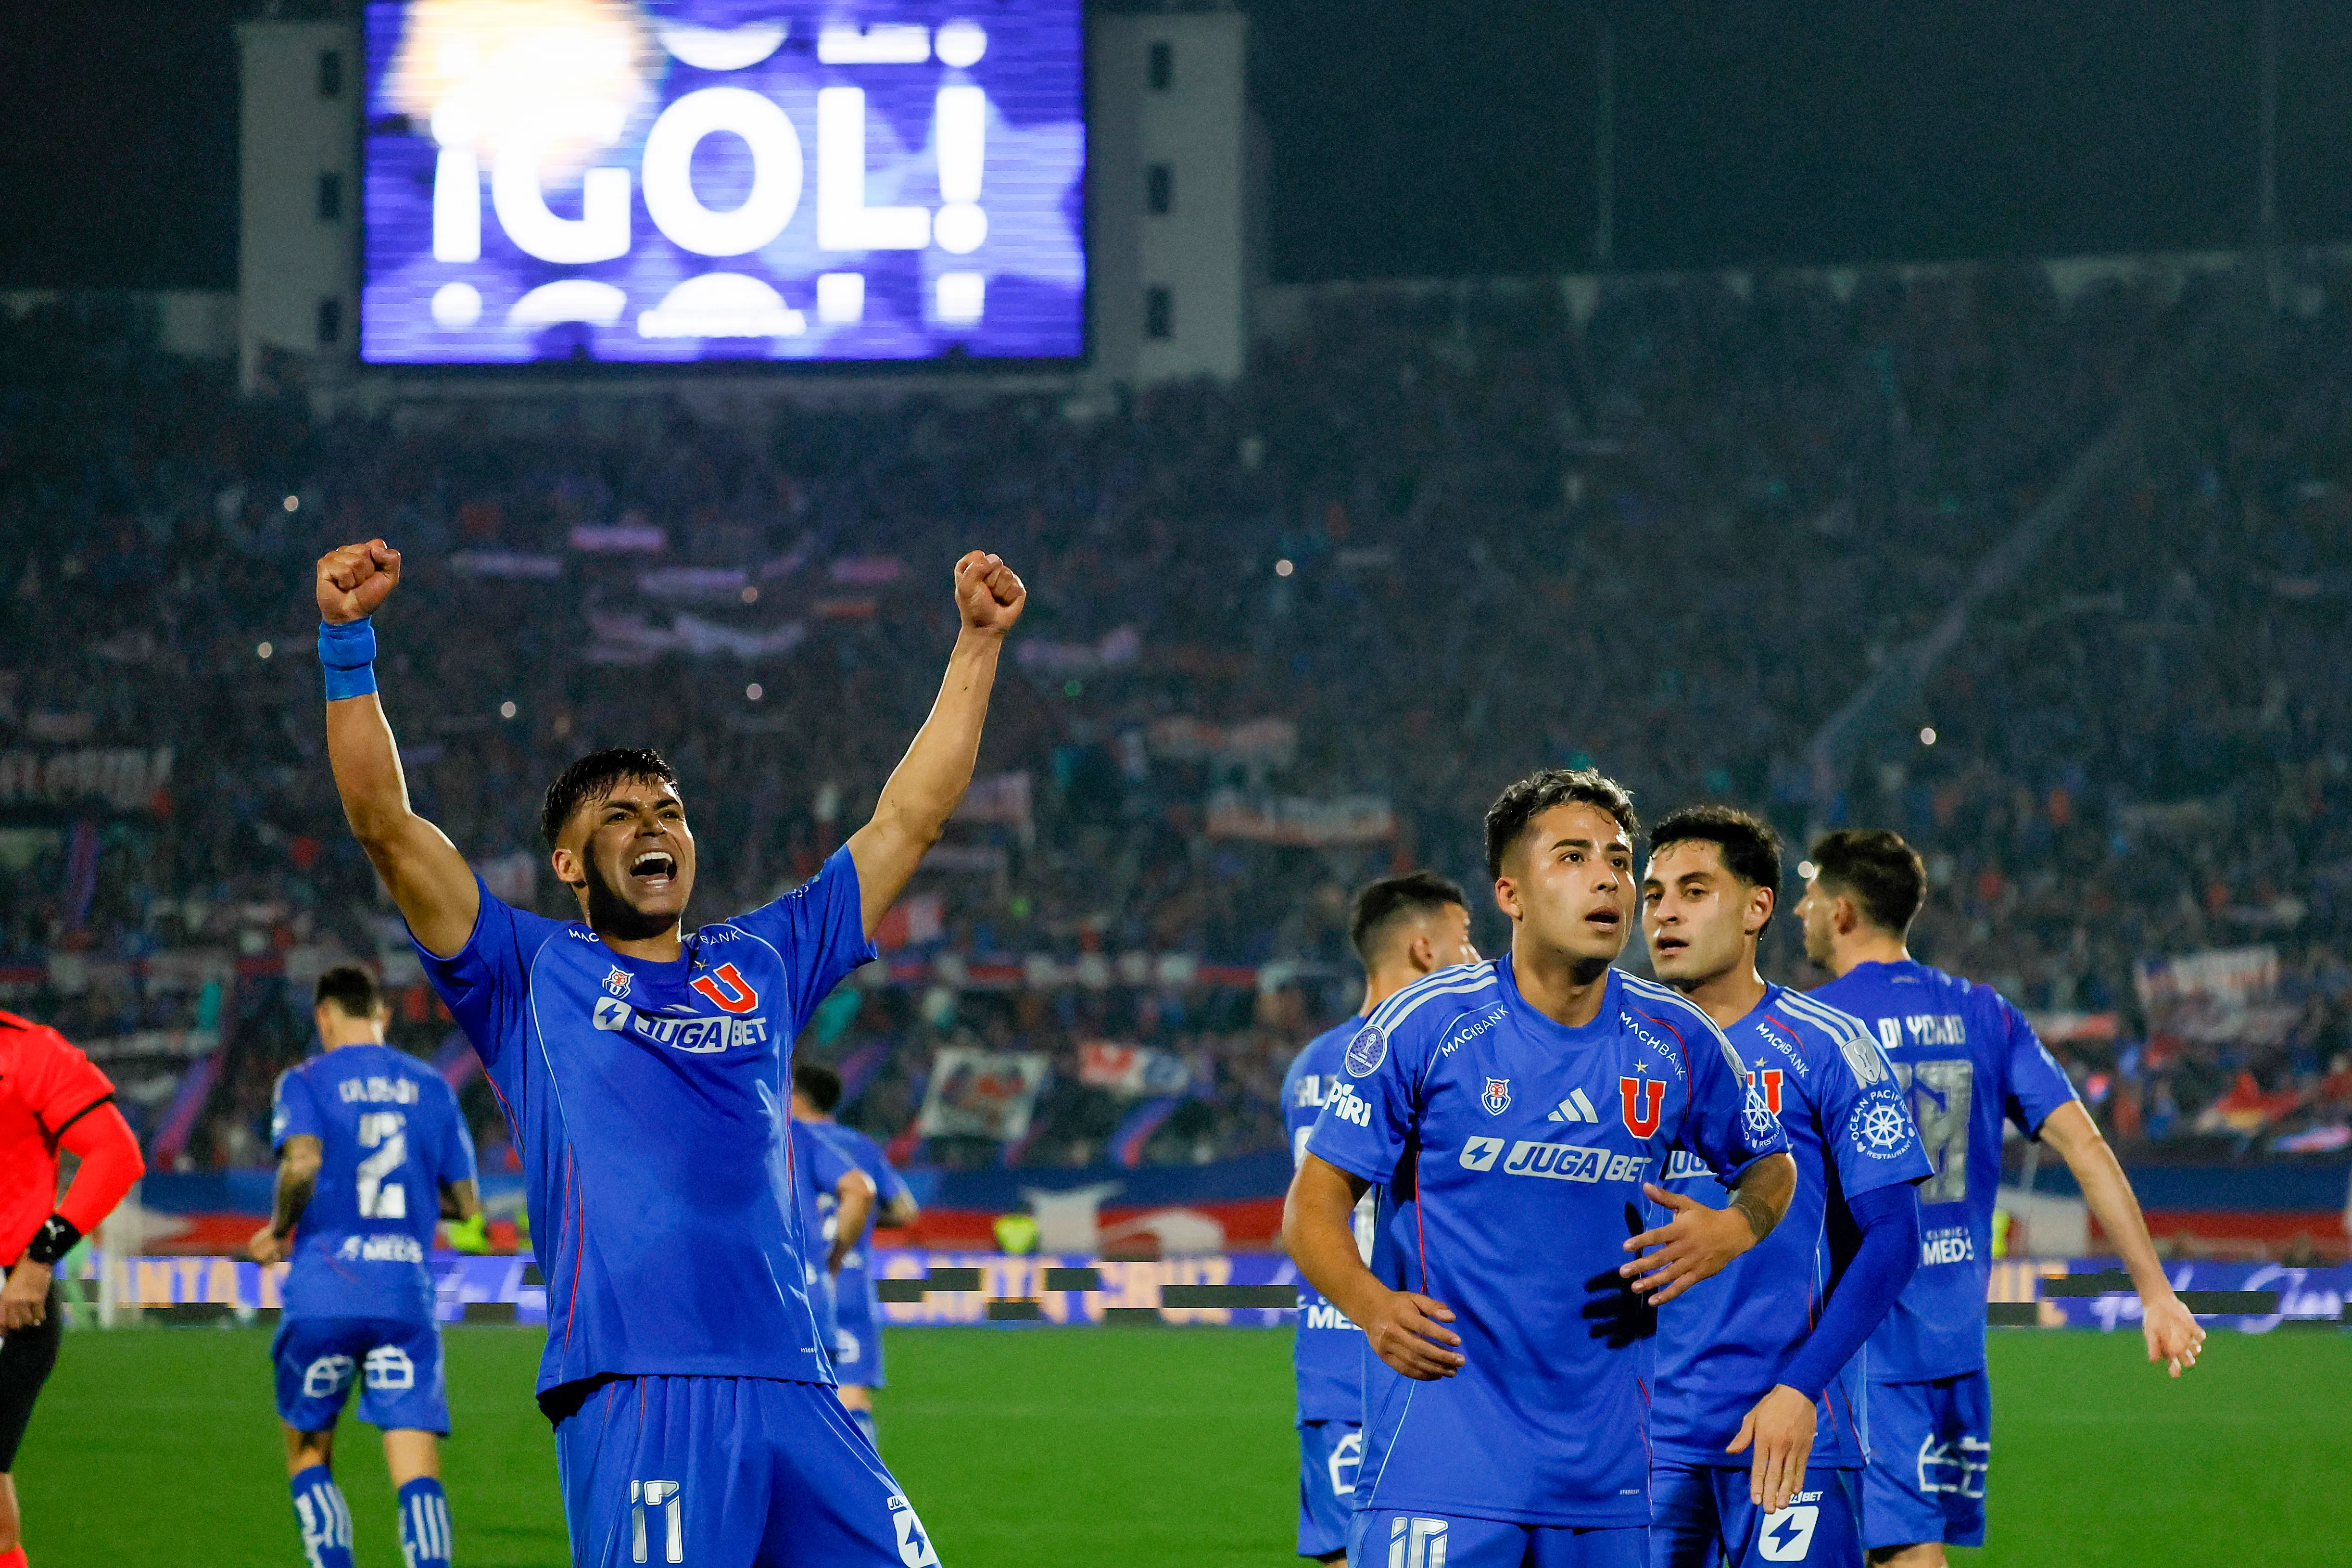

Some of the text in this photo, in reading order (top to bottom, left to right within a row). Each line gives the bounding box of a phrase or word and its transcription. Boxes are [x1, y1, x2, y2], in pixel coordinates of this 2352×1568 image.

[690, 961, 759, 1014] U
[1441, 1004, 1509, 1057] MACHBANK
[1619, 1011, 1686, 1081] MACHBANK
[1756, 1022, 1809, 1078] MACHBANK
[1619, 1076, 1667, 1140] U
[1849, 1098, 1869, 1141] OCEAN
[356, 1111, 407, 1219] 2
[1867, 1138, 1912, 1160] RESTAURANT
[1307, 1304, 1363, 1331] ME
[630, 1479, 684, 1564] 17
